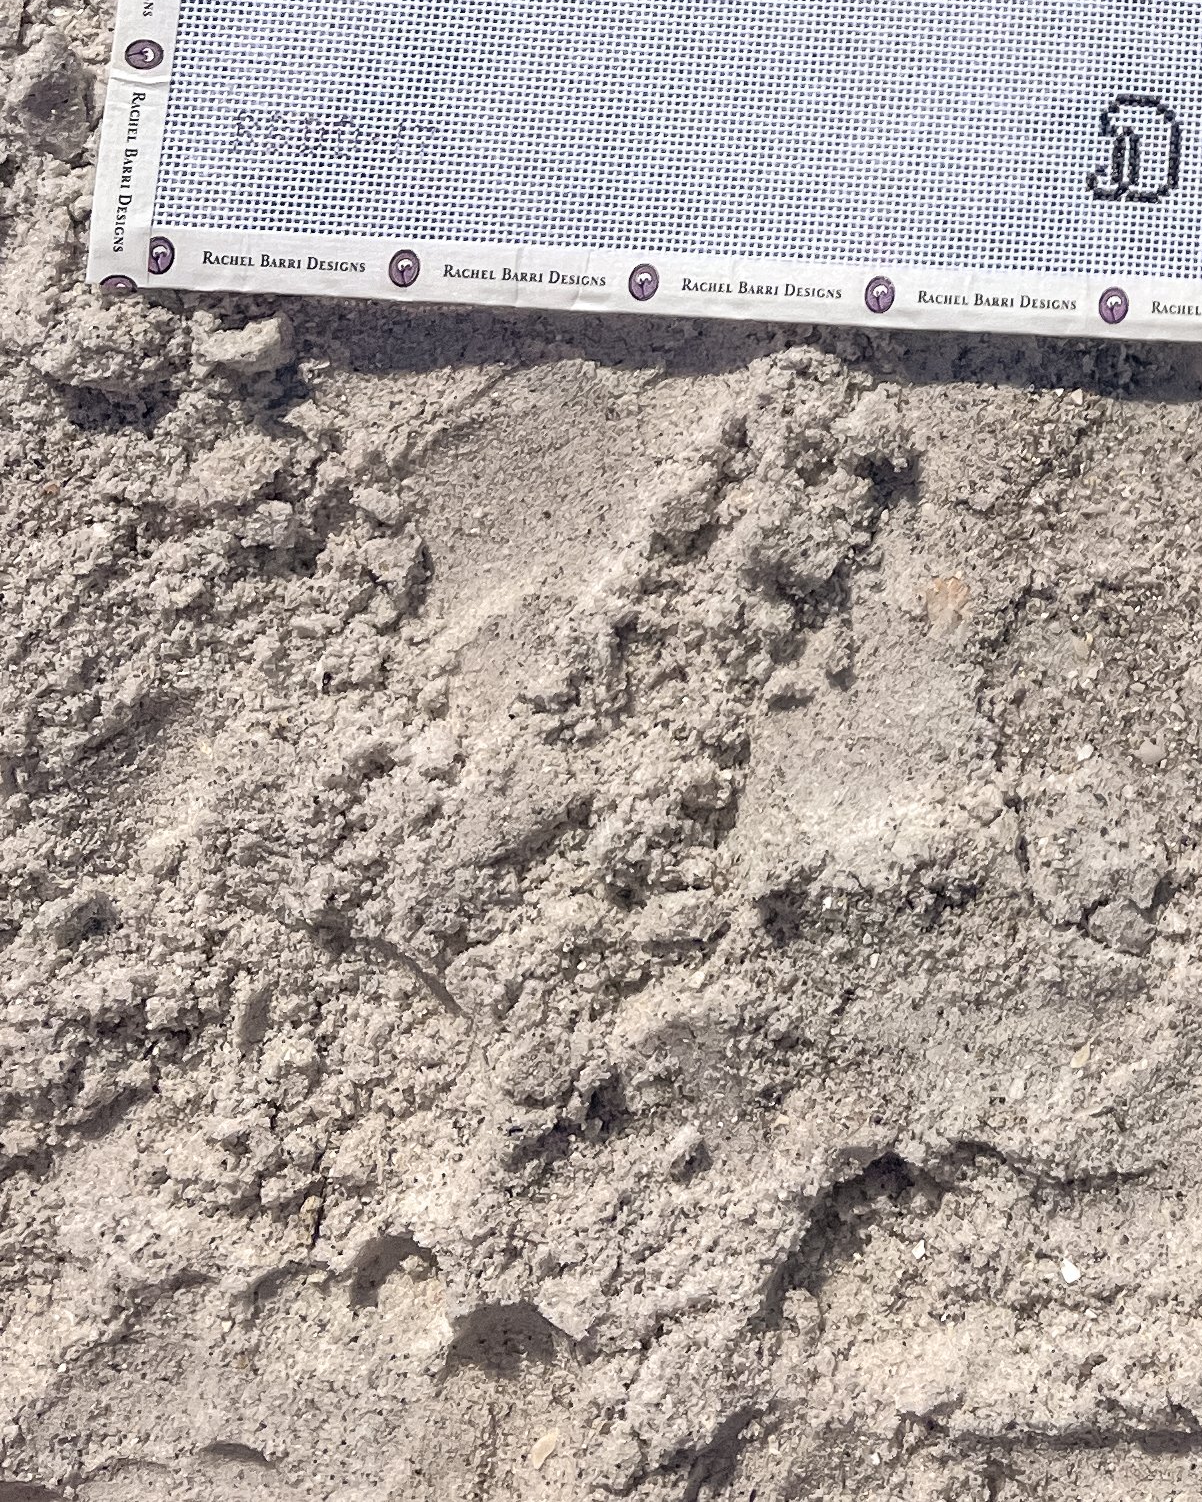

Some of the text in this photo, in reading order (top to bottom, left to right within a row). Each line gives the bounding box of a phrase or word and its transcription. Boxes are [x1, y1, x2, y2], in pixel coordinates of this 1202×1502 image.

[112, 92, 146, 253] RACHEL BARRI DESIGNS
[202, 250, 366, 273] RACHEL BARRI DESIGNS
[443, 264, 606, 287] RACHEL BARRI DESIGNS
[681, 277, 842, 299] RACHEL BARRI DESIGNS
[917, 290, 1077, 310] RACHEL BARRI DESIGNS
[1151, 300, 1202, 316] RACHEL
